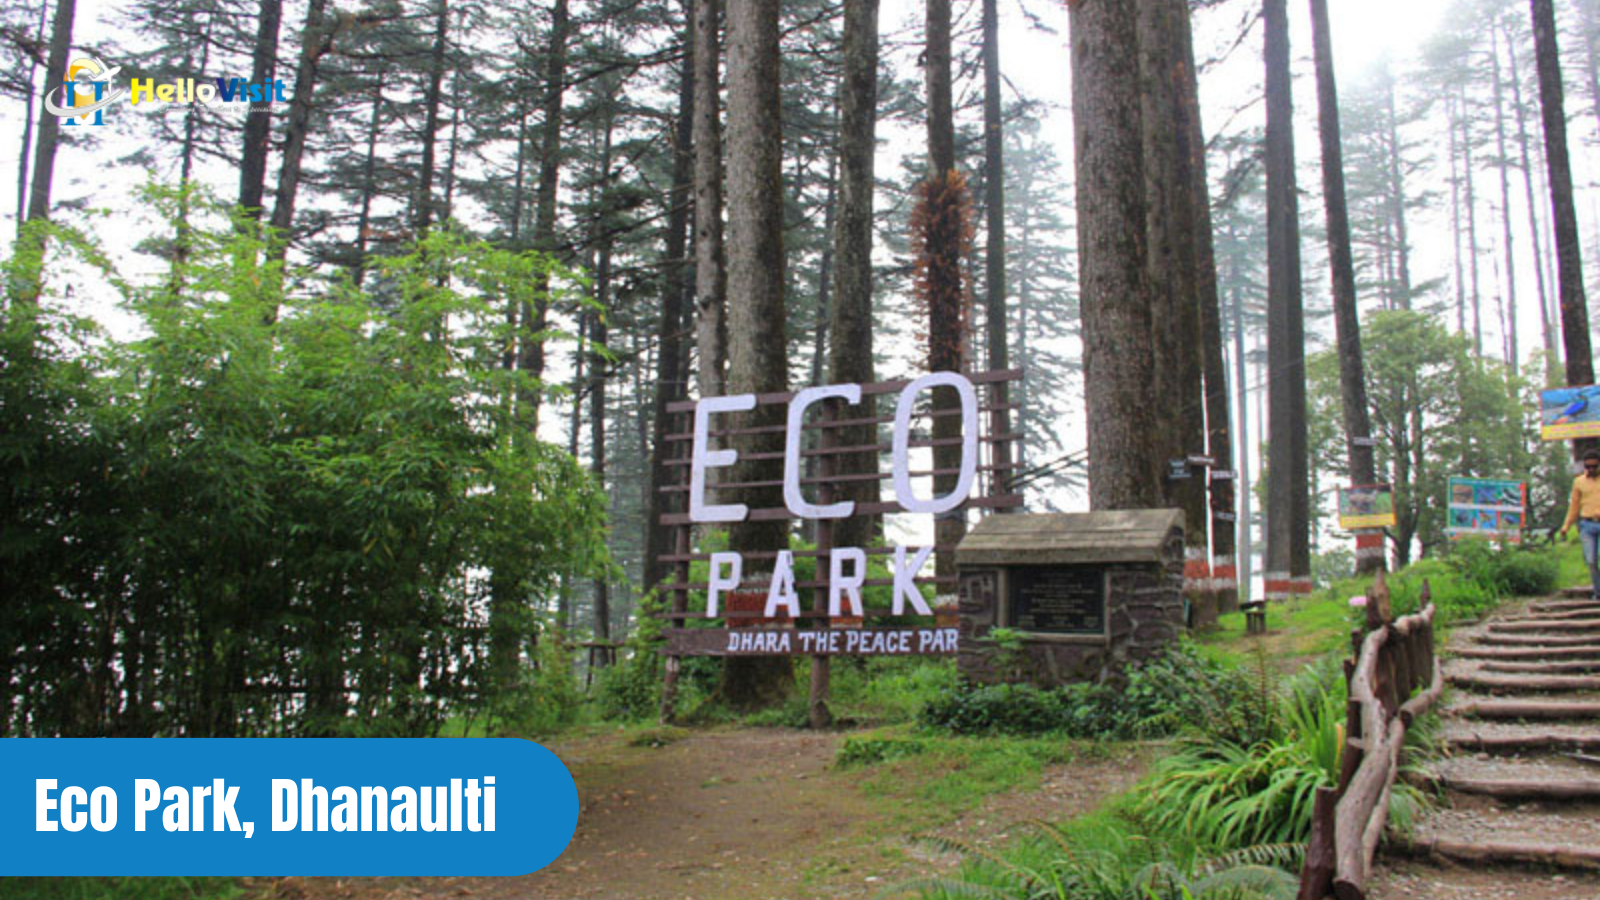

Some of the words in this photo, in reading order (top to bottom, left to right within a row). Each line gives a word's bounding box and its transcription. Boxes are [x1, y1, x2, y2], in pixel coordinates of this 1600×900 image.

[690, 371, 978, 522] ECO
[706, 545, 933, 617] PARK
[728, 631, 791, 652] DHARA
[798, 630, 839, 652] THE
[845, 629, 912, 652] PEACE
[919, 628, 959, 651] PAR
